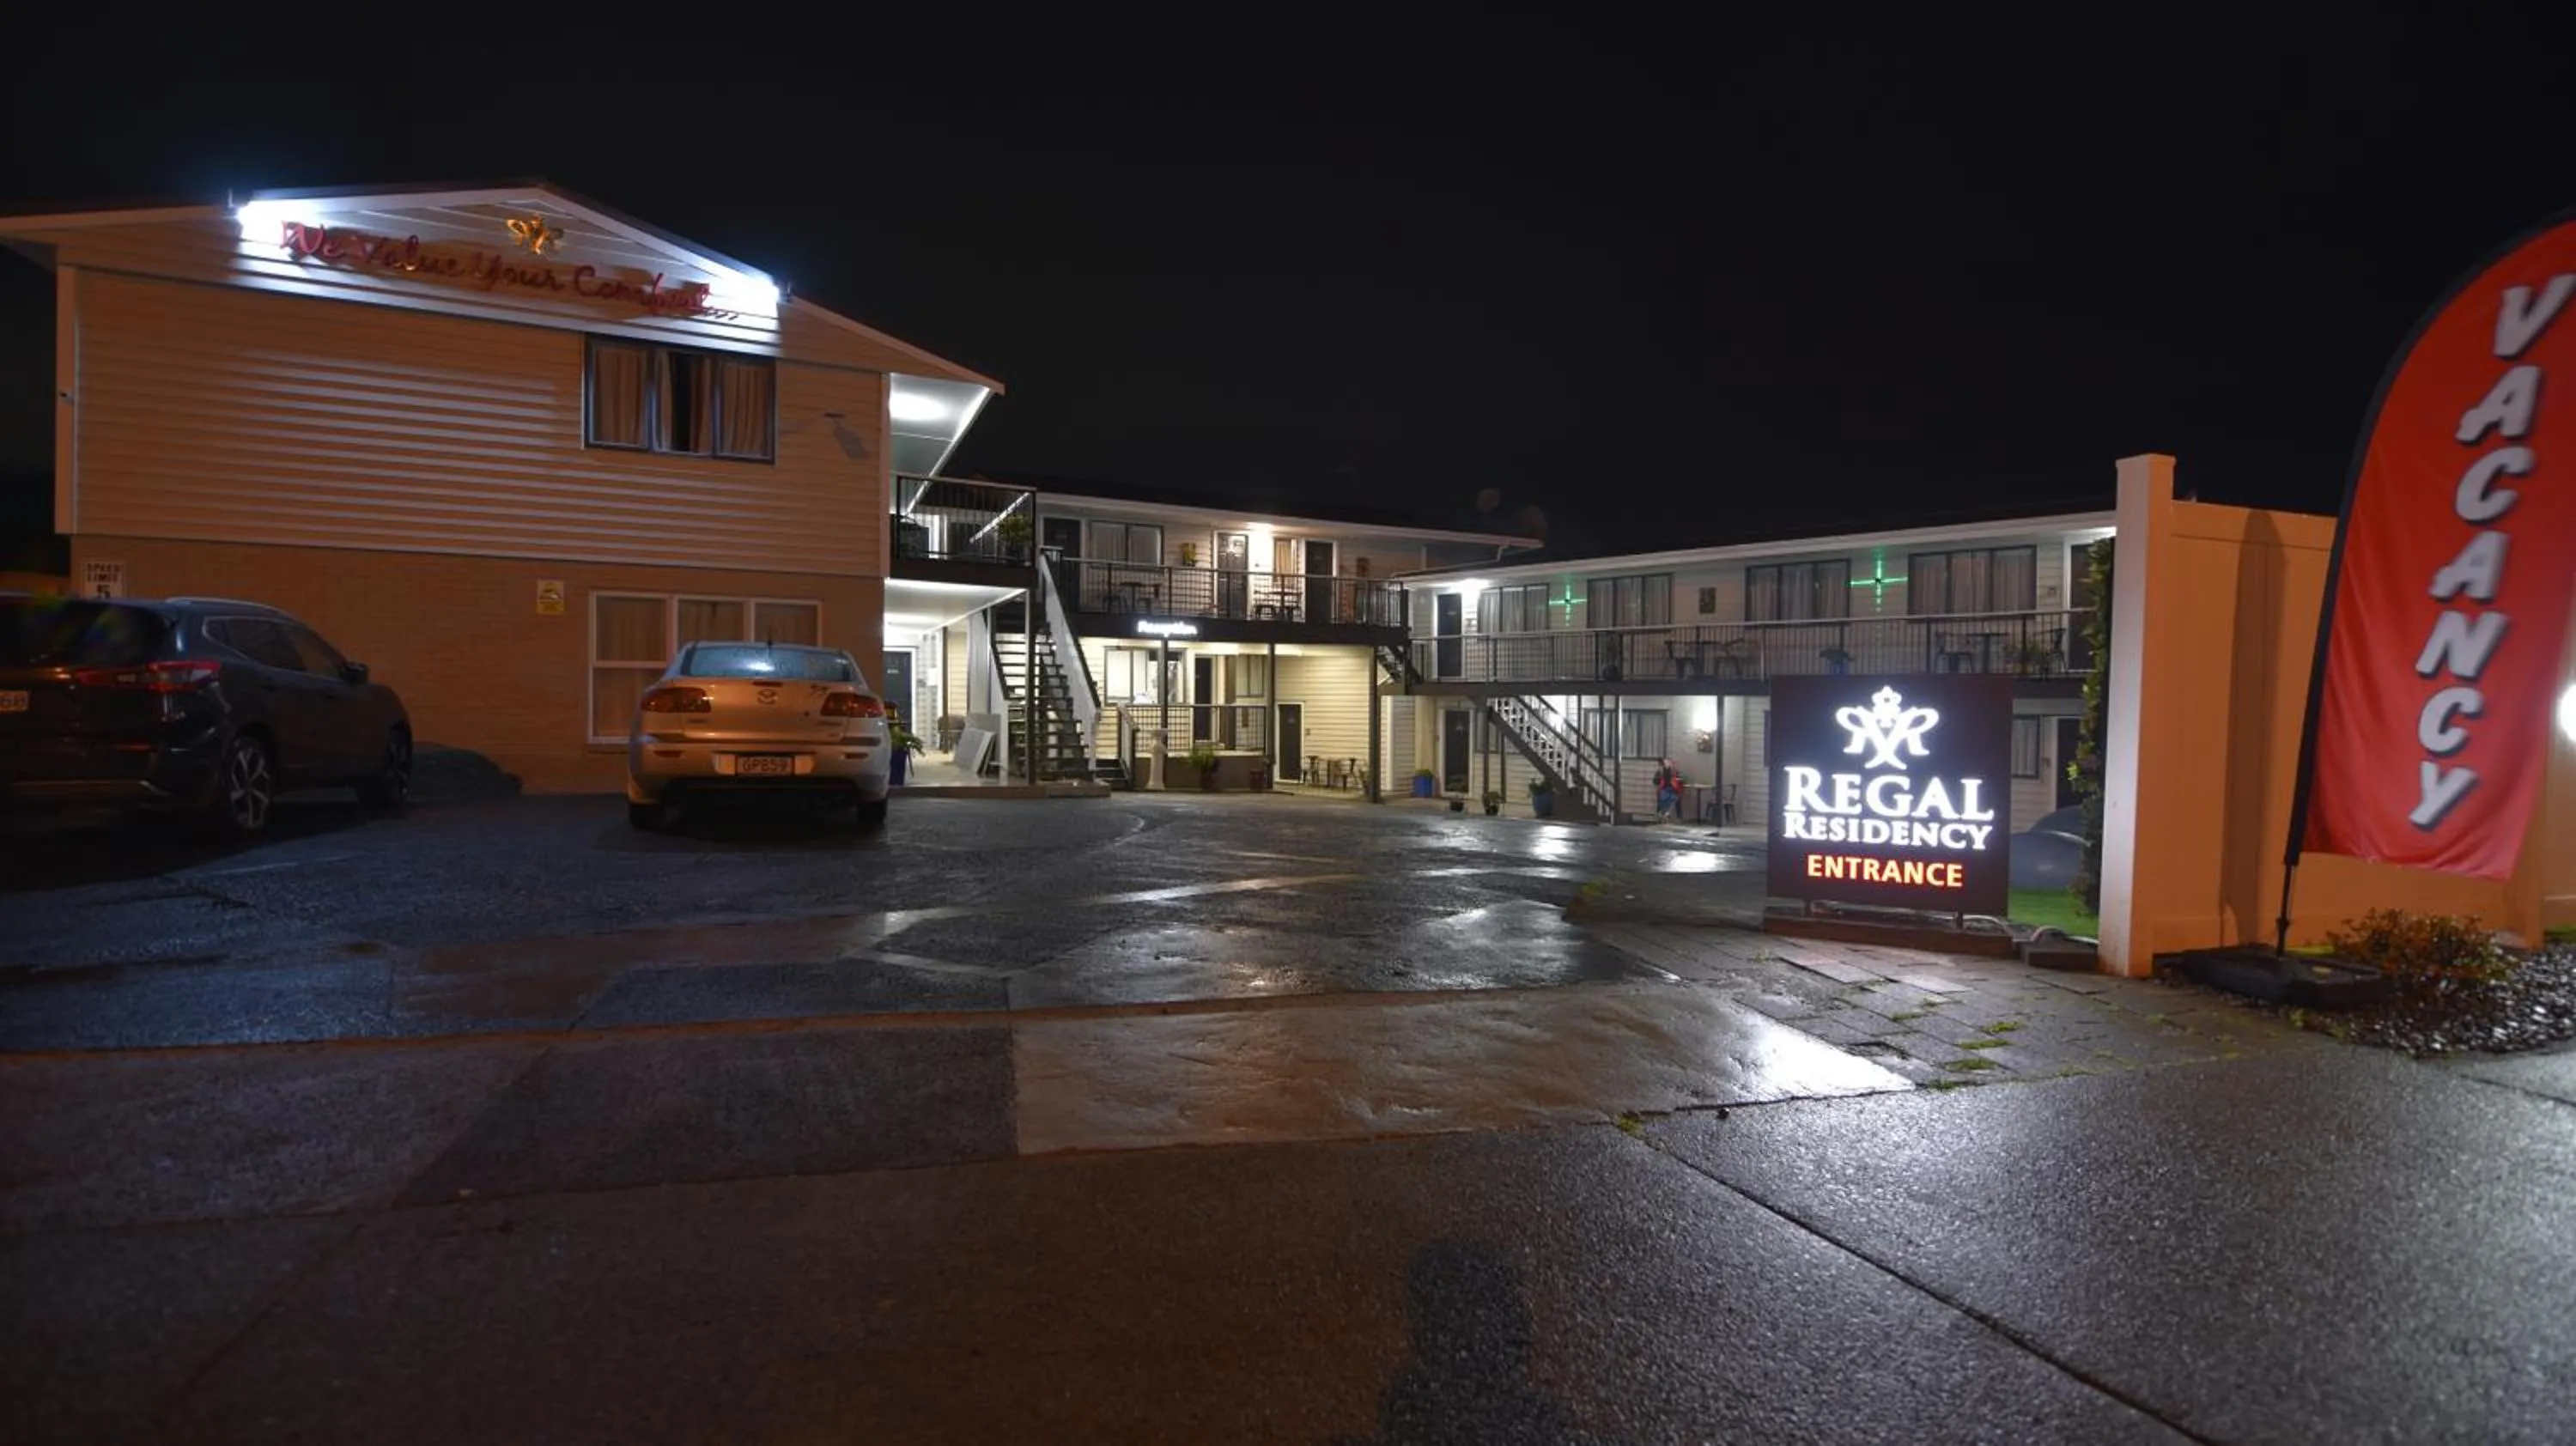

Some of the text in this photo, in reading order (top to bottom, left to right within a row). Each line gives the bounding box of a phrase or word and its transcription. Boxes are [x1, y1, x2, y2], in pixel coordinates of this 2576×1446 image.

[350, 234, 466, 277] Value
[471, 251, 565, 292] Your
[2408, 270, 2575, 833] VACANCY
[87, 562, 121, 573] SPEED
[87, 573, 118, 583] LIMIT
[96, 584, 111, 599] 5
[1806, 854, 1965, 889] ENTRANCE
